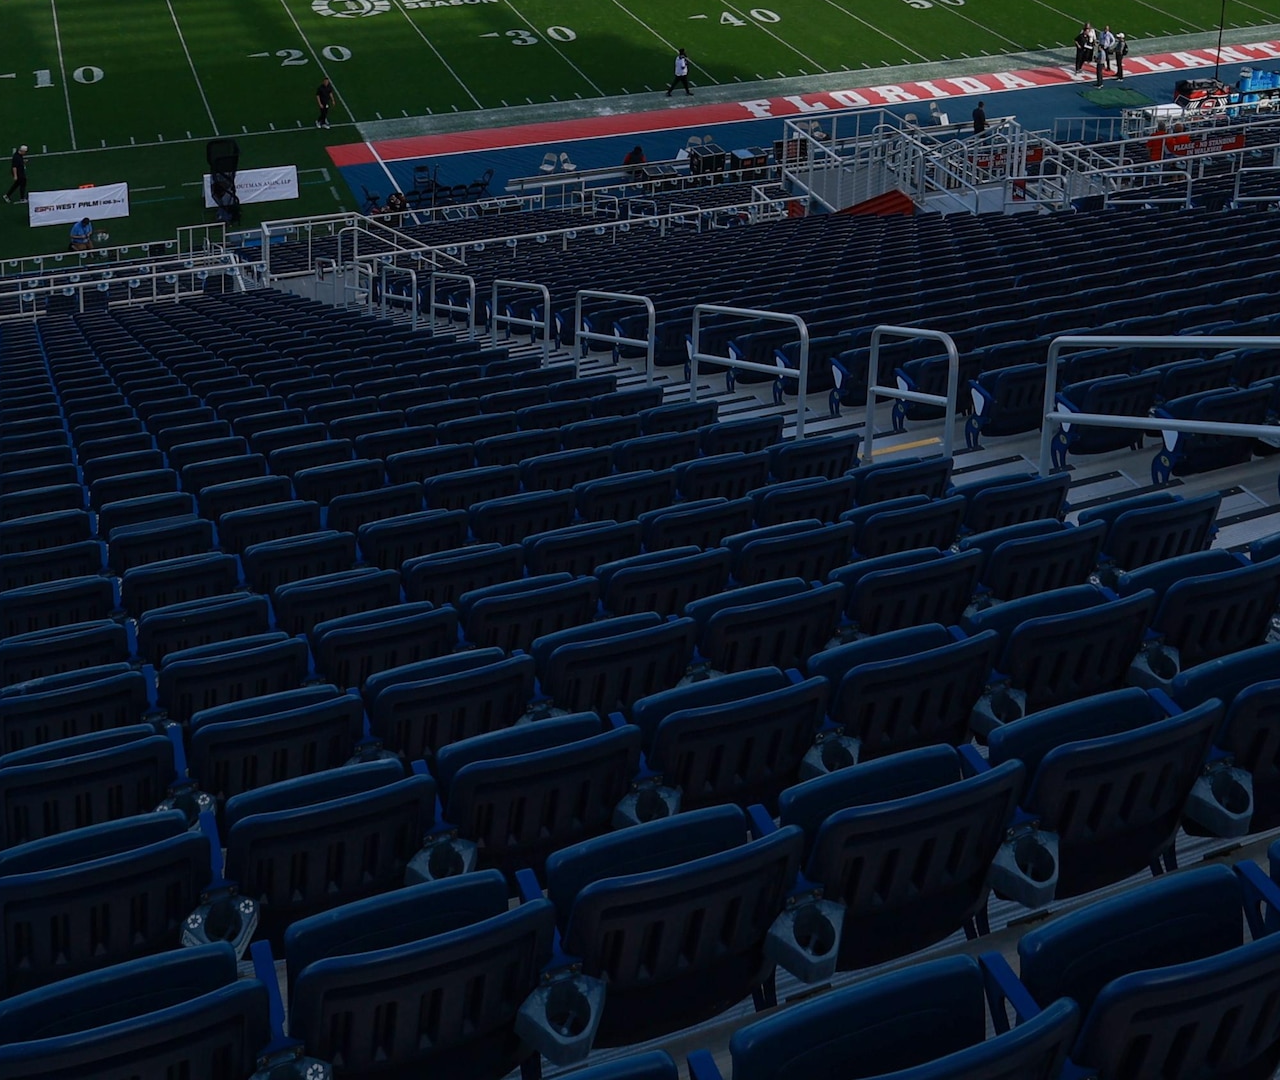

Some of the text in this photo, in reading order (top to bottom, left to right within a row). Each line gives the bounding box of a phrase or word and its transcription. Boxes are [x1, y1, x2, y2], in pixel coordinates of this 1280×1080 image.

[720, 7, 781, 28] 40
[506, 26, 578, 47] 30
[280, 44, 353, 67] 20
[33, 65, 105, 90] 10
[739, 71, 1035, 118] FLORIDA
[1173, 142, 1195, 151] PLEASE
[1207, 136, 1236, 147] STANDING
[34, 200, 99, 213] ESPN WEST PALM
